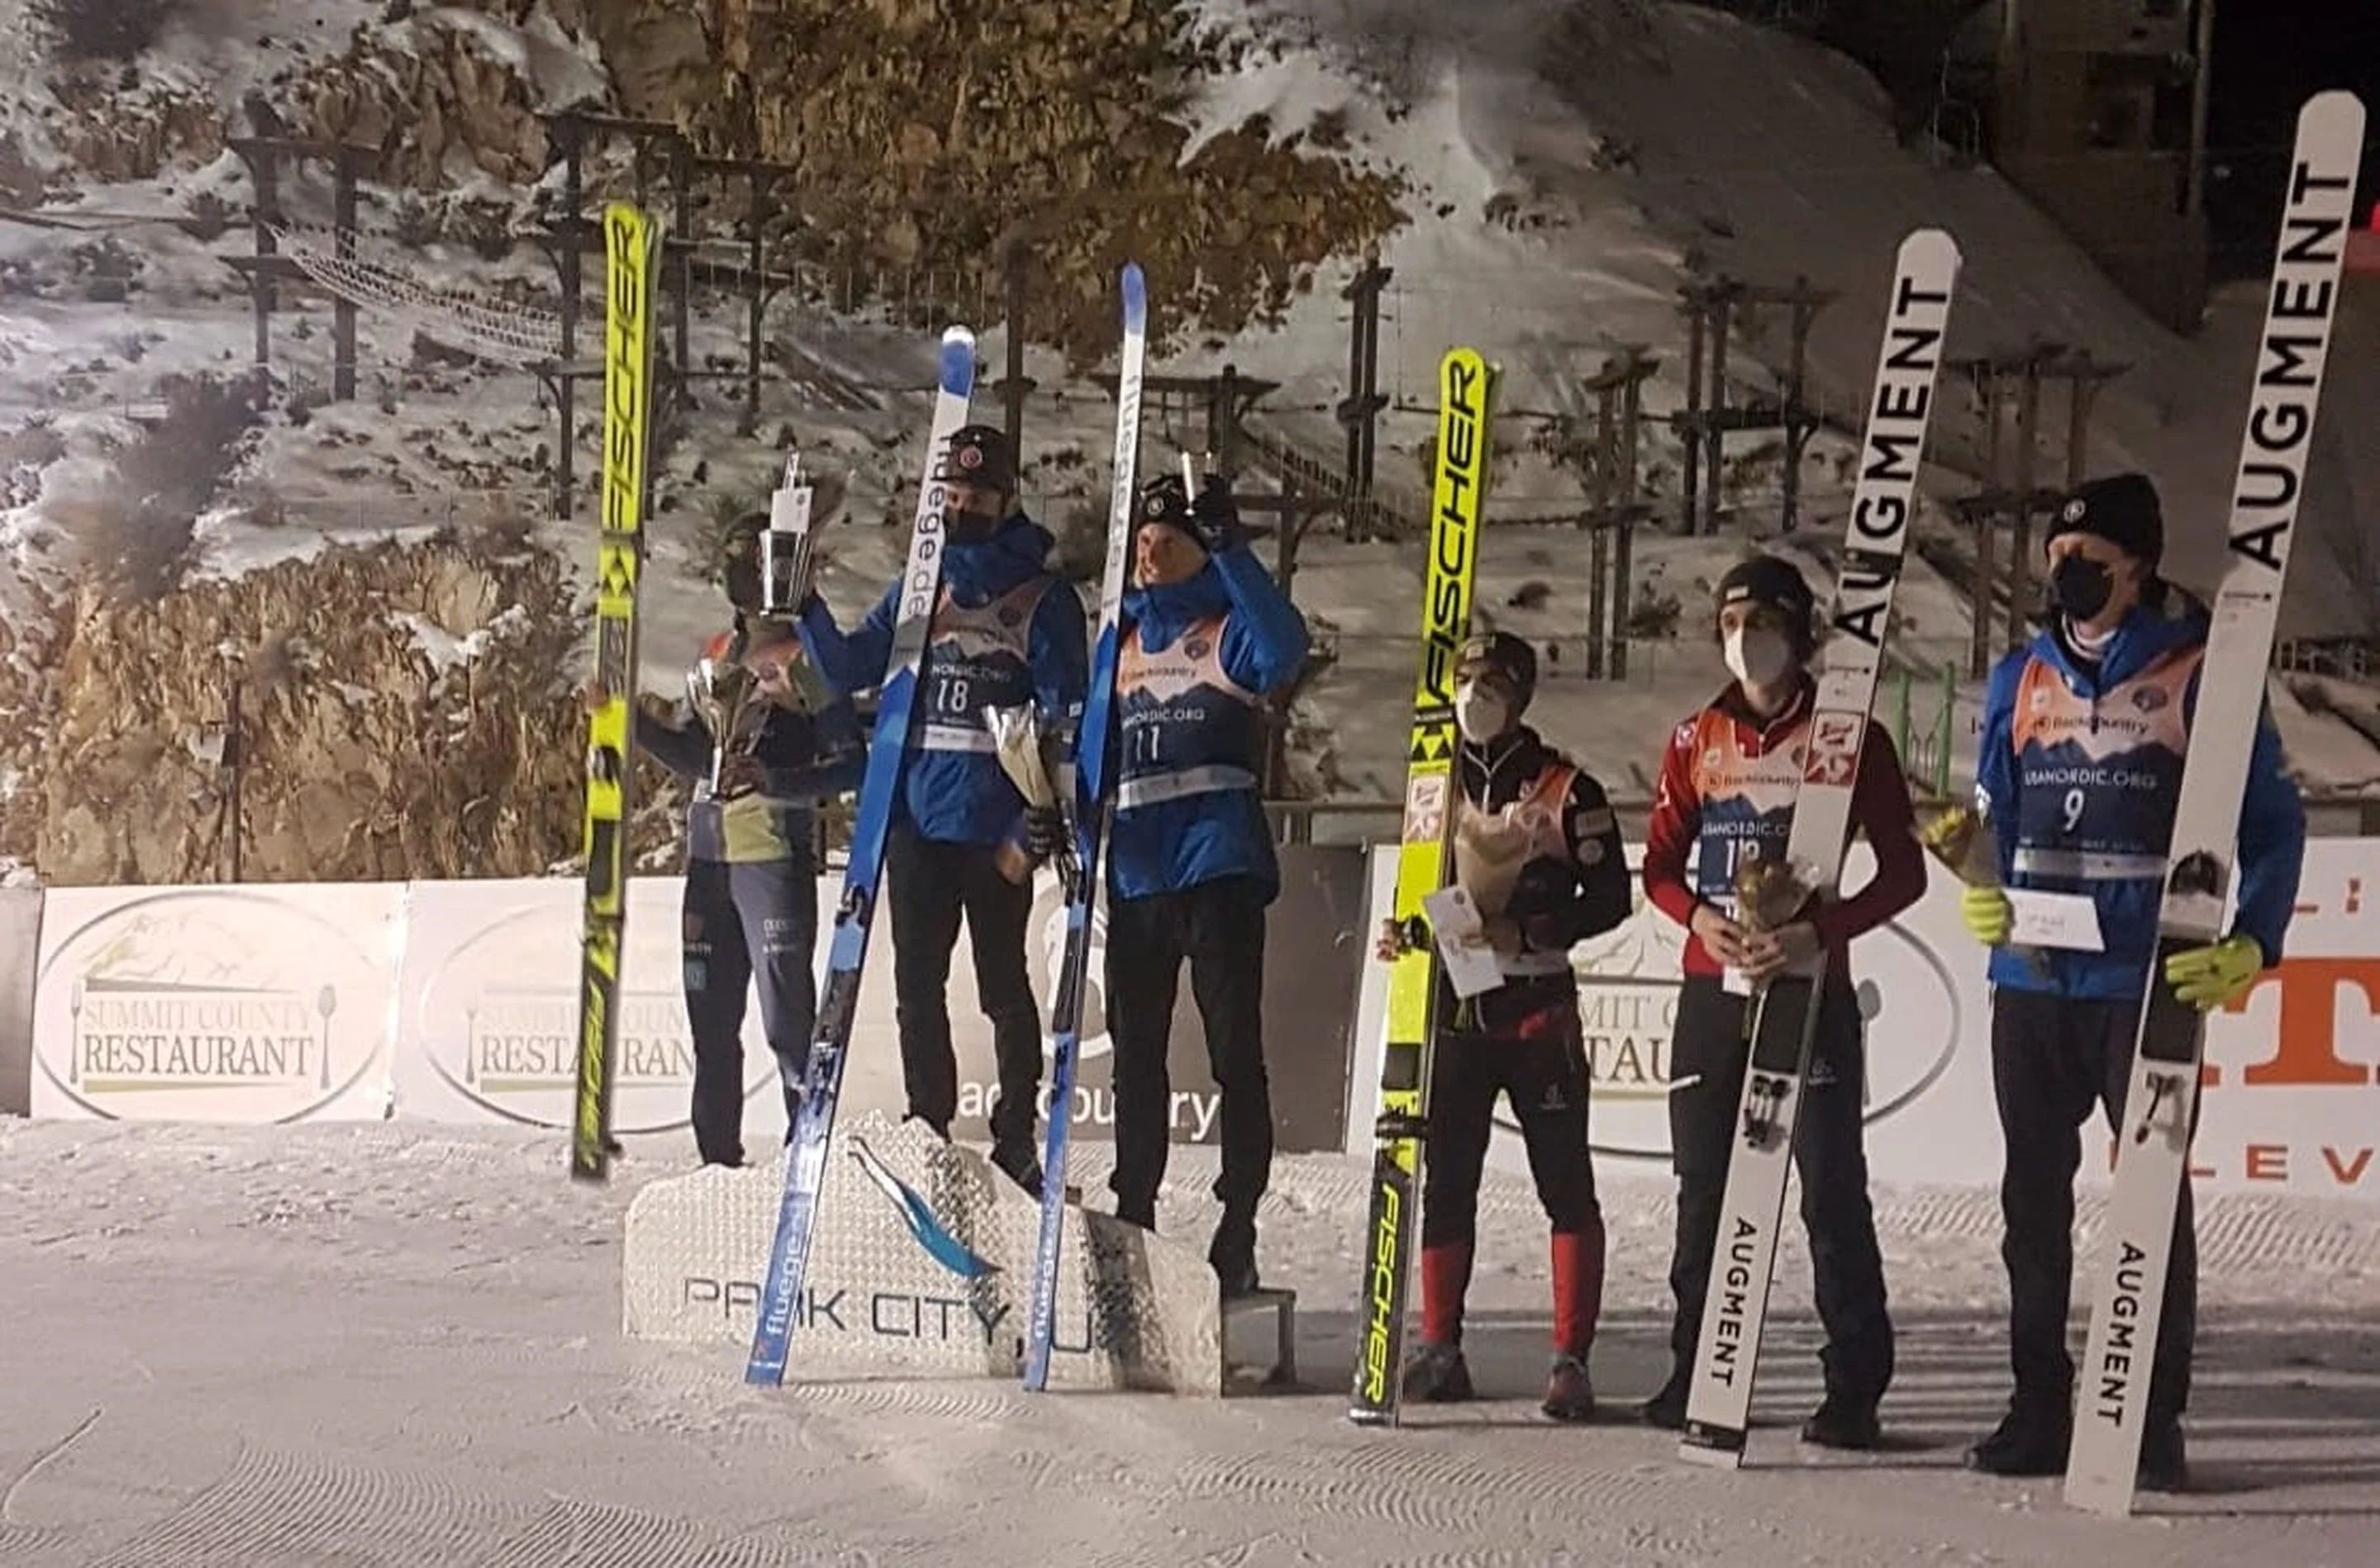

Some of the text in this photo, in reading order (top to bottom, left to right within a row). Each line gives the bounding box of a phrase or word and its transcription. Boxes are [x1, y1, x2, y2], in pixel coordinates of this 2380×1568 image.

[611, 219, 636, 530] FISCHER
[2229, 161, 2349, 571] AUGMENT
[1425, 359, 1477, 708] FISCHER
[937, 678, 968, 712] 18
[1136, 725, 1160, 762] 11
[2063, 788, 2085, 832] 9
[83, 1034, 313, 1075] RESTAURANT
[1365, 1181, 1401, 1404] FISCHER
[1711, 1216, 1758, 1388] AUGMENT
[2097, 1241, 2145, 1428] AUGMENT
